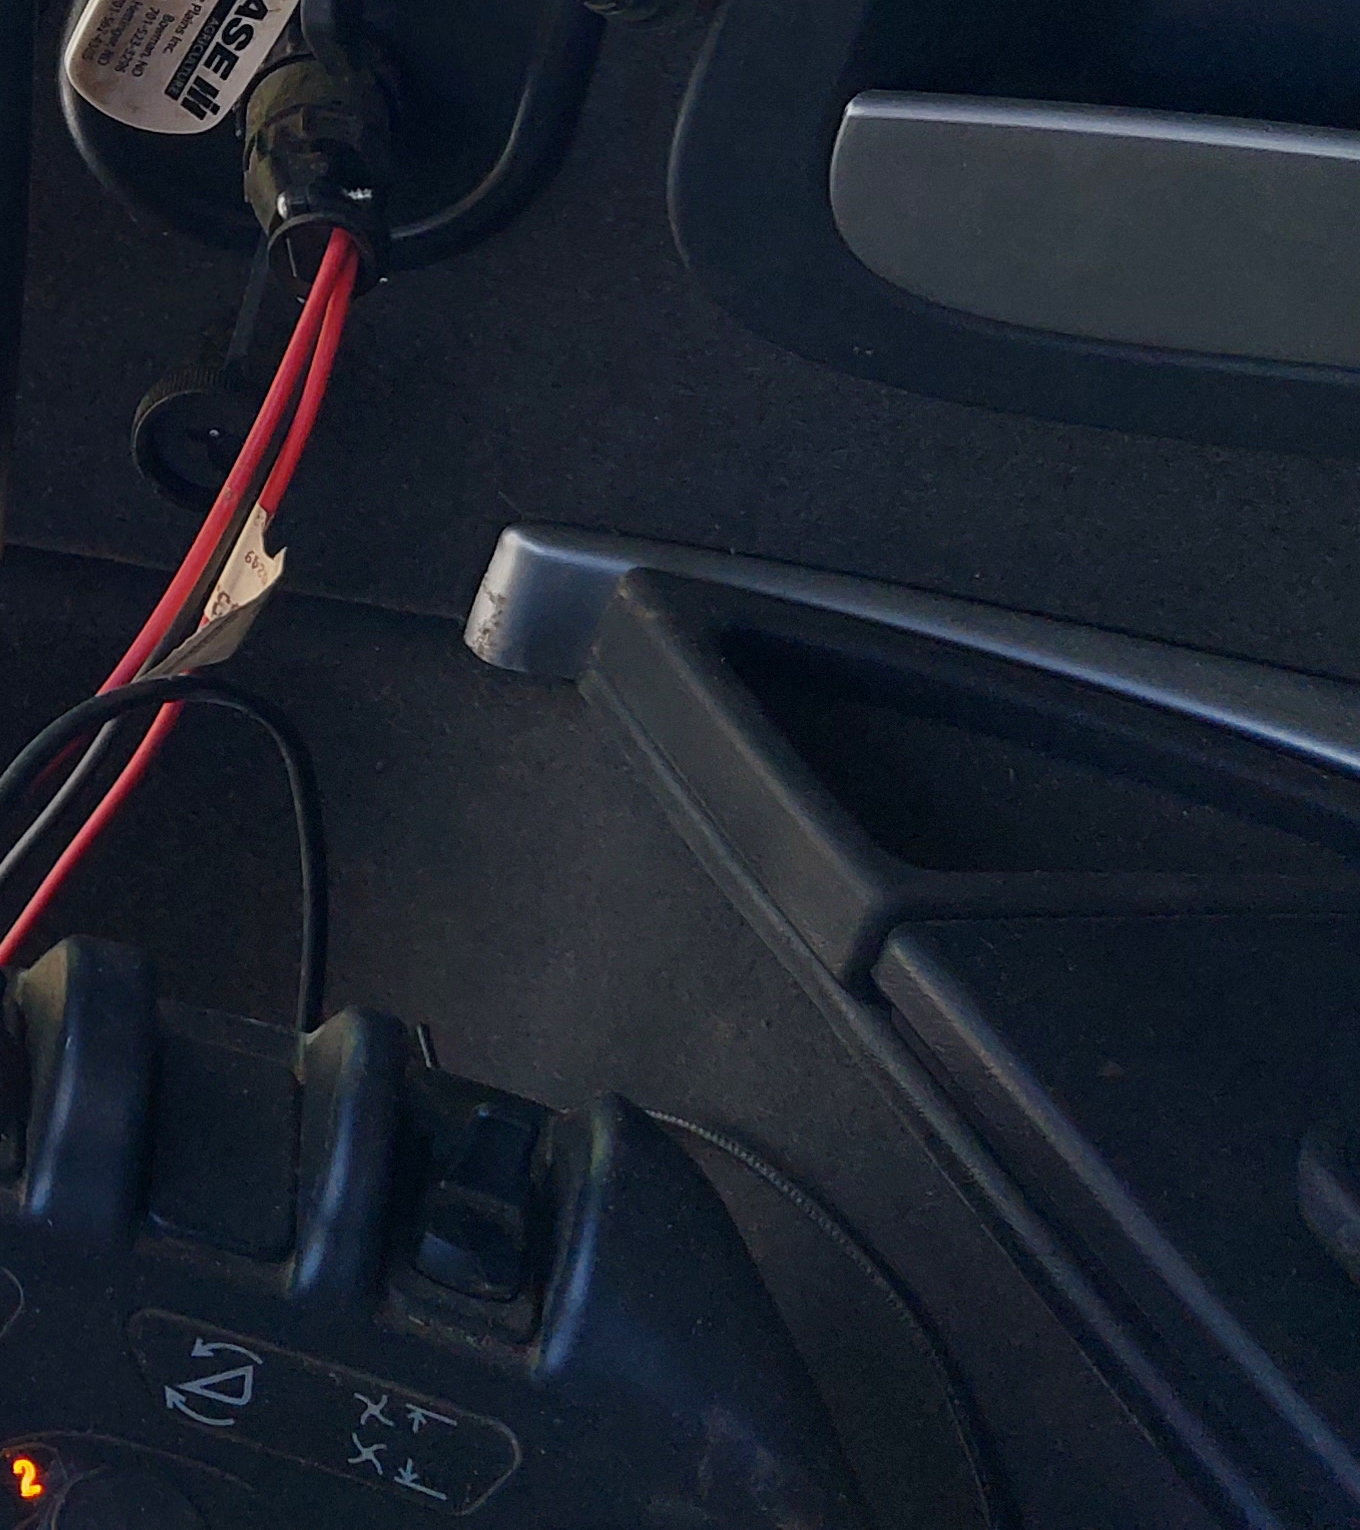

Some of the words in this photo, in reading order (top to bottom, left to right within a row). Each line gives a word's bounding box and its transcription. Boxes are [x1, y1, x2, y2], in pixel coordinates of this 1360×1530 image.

[179, 3, 202, 36] Plains
[132, 60, 149, 77] ND
[168, 17, 221, 97] AGRICULTURE
[12, 1458, 43, 1498] 2
